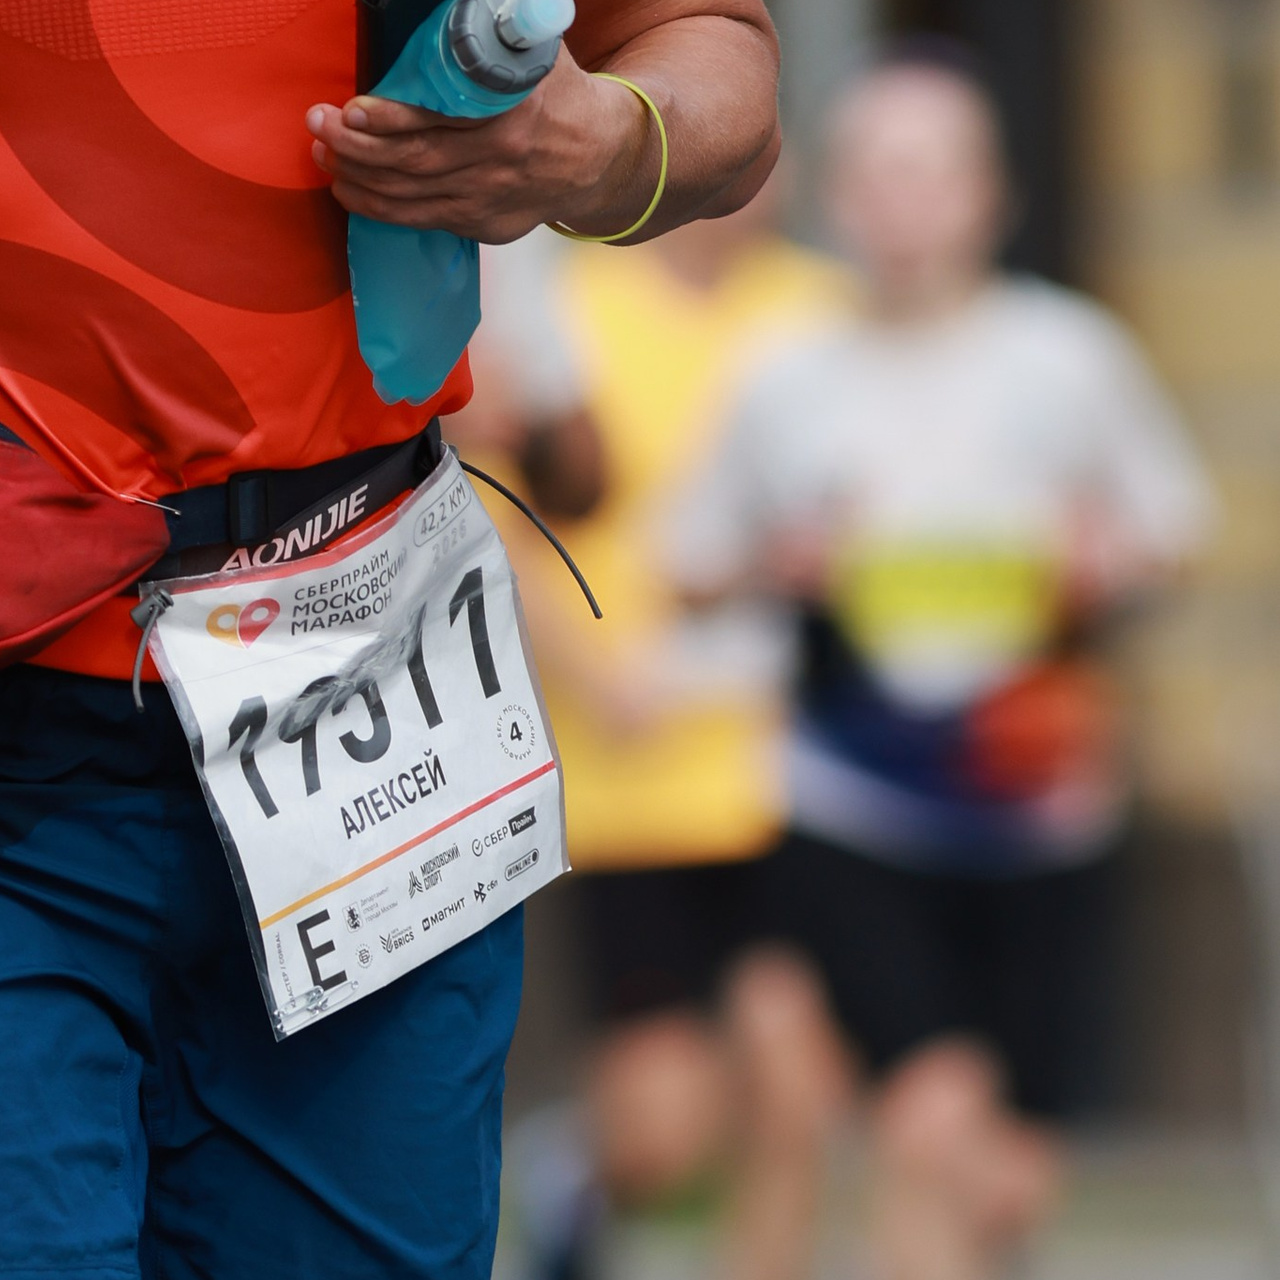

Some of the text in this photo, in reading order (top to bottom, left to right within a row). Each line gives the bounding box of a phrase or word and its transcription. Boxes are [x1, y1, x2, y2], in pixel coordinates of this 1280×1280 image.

[220, 483, 368, 571] AONIJIE
[421, 502, 447, 535] 42,2
[292, 547, 408, 618] МОСКОВСКИЙ
[294, 549, 390, 601] СБЕРПРАЙМ
[291, 588, 392, 636] МАРАФОН
[510, 721, 523, 741] 4
[340, 748, 447, 840] АЛЕКСЕЙ
[483, 826, 508, 848] СБЕР
[420, 843, 461, 877] МОСКОВСКИЙ
[423, 870, 443, 891] СПОРТ
[393, 931, 415, 949] BRICS
